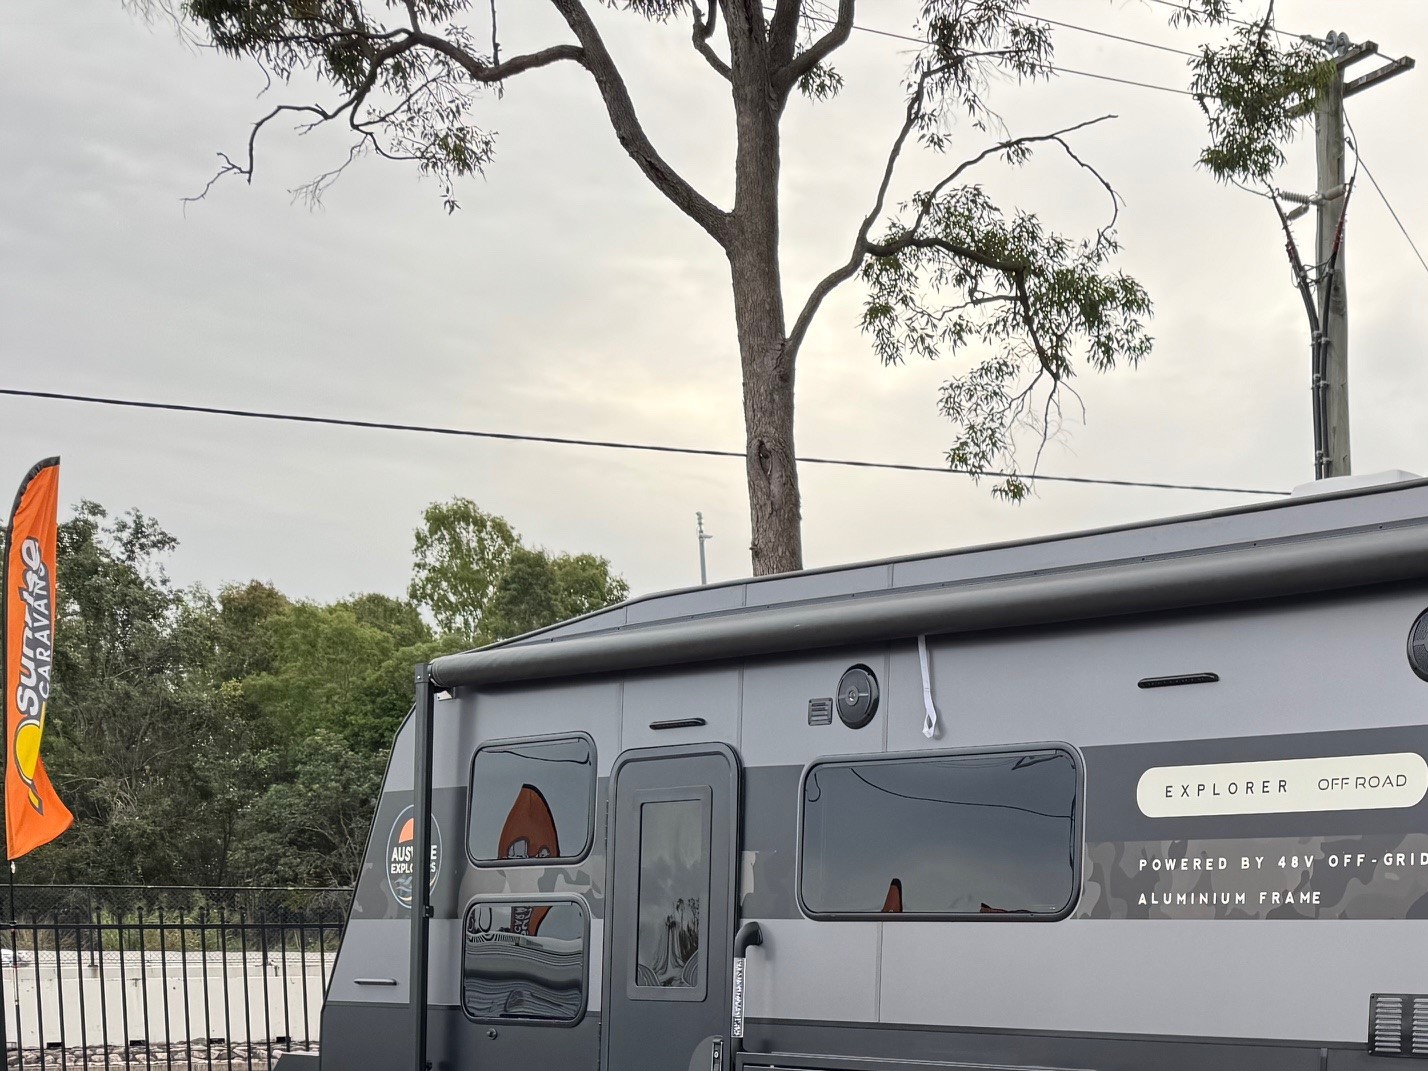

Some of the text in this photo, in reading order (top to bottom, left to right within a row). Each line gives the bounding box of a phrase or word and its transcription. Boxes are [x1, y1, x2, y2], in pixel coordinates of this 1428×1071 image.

[1165, 774, 1407, 798] EXPLORER OFF ROAD
[1139, 856, 1228, 871] POWERED
[1241, 856, 1265, 870] BY
[1277, 854, 1315, 869] 48V
[1137, 891, 1322, 906] ALUMINIUM FRAME
